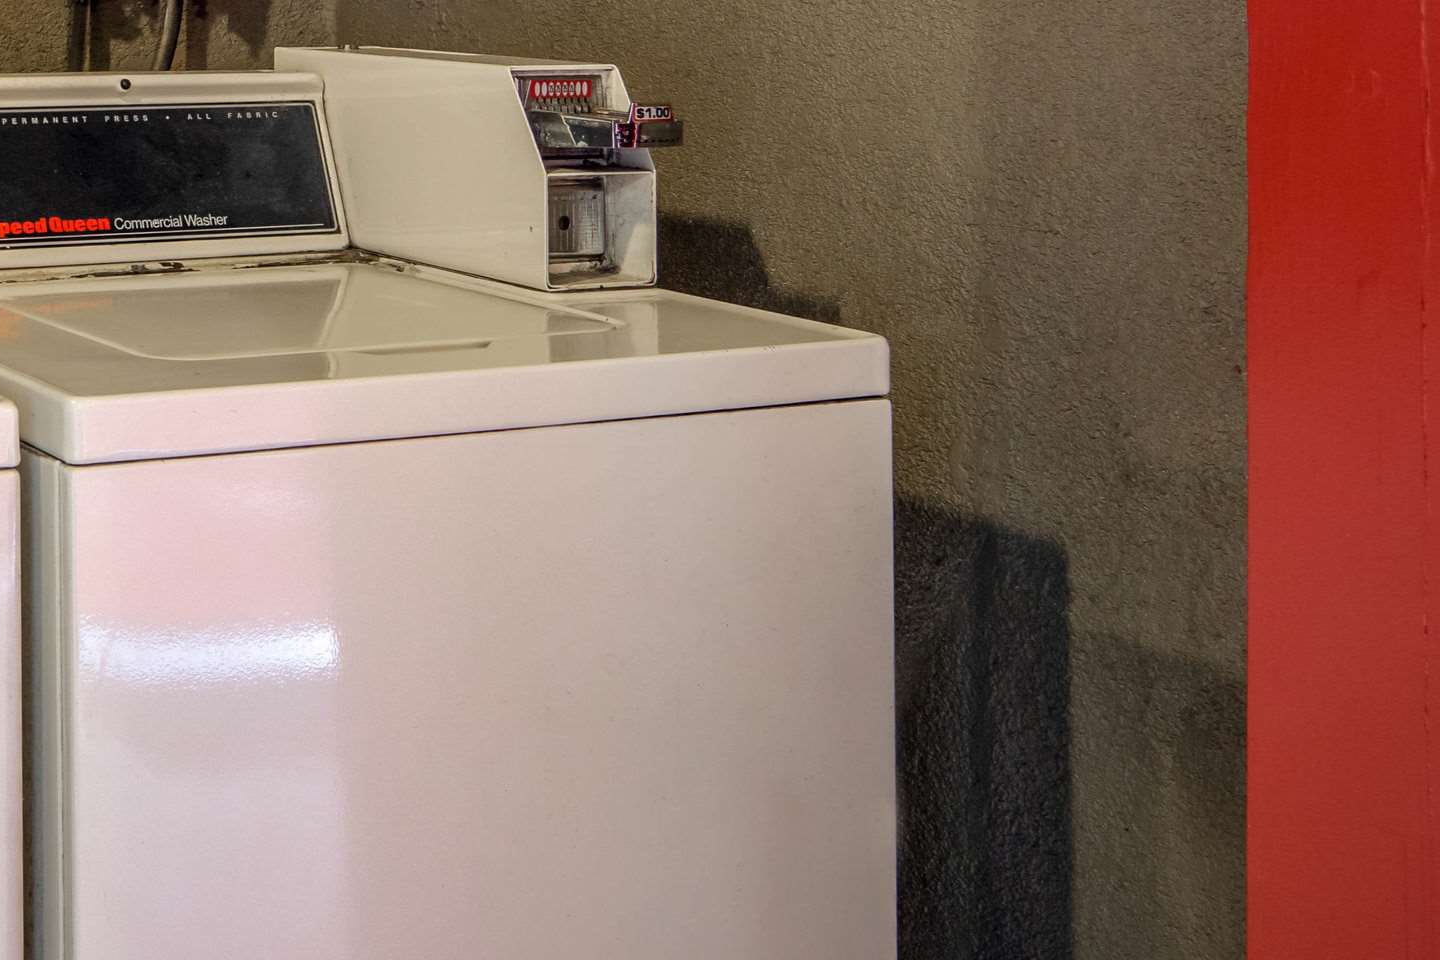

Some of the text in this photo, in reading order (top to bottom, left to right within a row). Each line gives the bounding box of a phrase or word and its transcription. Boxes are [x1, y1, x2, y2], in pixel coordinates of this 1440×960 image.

[1, 110, 279, 125] PERMANENT PRESS ALL FABRIC
[637, 108, 669, 118] $1.00
[48, 216, 111, 233] Queen
[113, 213, 228, 230] Commercial Washer
